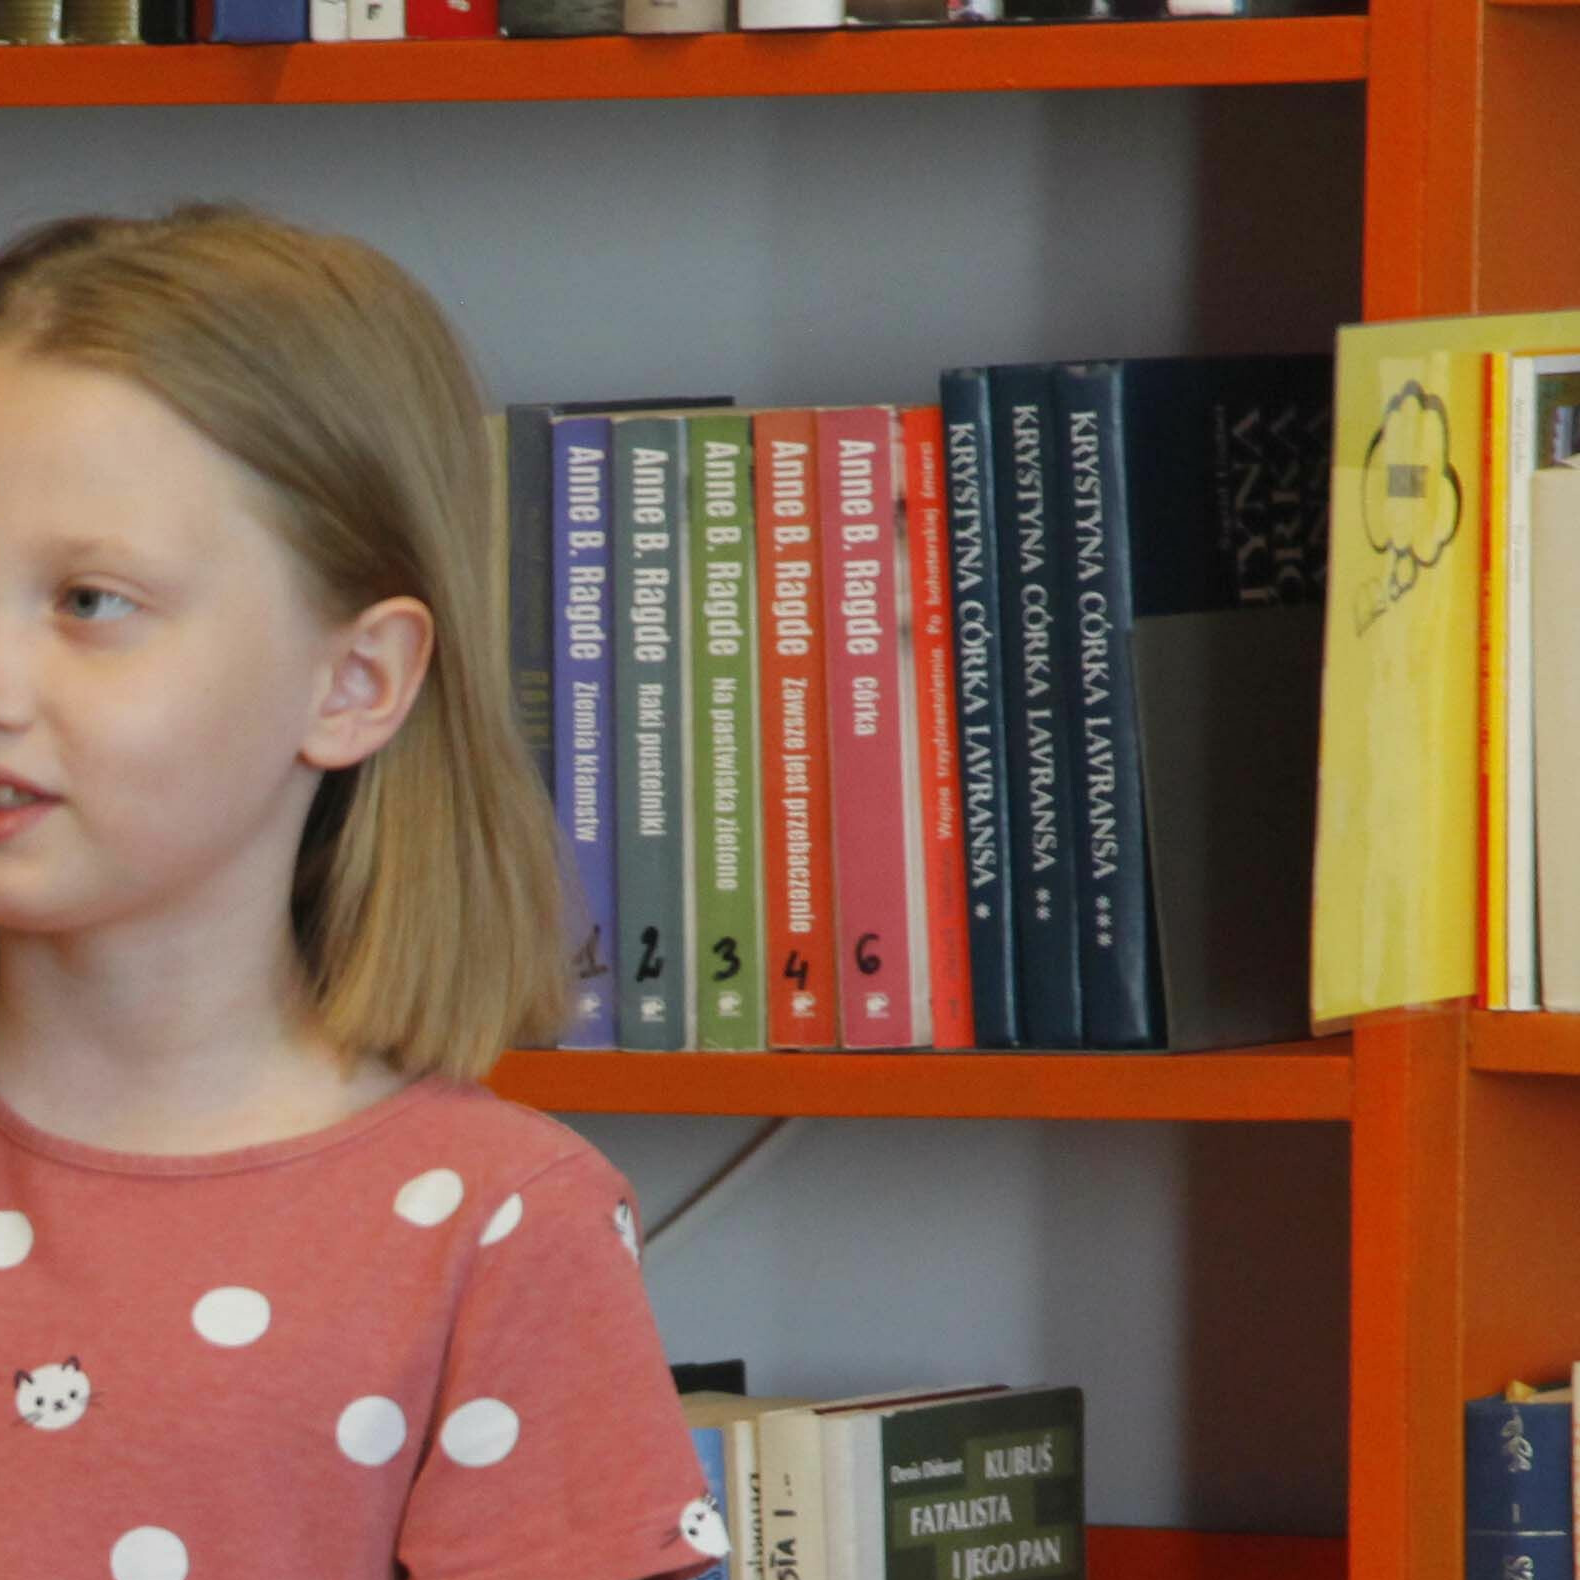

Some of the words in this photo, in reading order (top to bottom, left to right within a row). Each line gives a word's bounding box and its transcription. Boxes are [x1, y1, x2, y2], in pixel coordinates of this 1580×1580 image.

[567, 446, 604, 522] Anne
[632, 448, 668, 524] Anne
[705, 441, 739, 517] Anne
[771, 441, 808, 517] Anne
[838, 440, 875, 515] Anne
[949, 423, 983, 592] KRYSTYNA
[1012, 405, 1045, 574] KRYSTYNA
[1070, 411, 1104, 580] KRYSTYNA
[569, 530, 605, 557] B.
[633, 532, 670, 558] B.
[706, 526, 741, 552] B.
[774, 526, 810, 552] B.
[842, 524, 879, 550] B.
[566, 566, 607, 660] Ragde
[631, 568, 671, 662] Ragde
[704, 562, 742, 655] Ragde
[773, 561, 813, 655] Ragde
[842, 560, 883, 655] Ragde
[1021, 585, 1054, 697] CÓRKA
[958, 600, 993, 714] CÓRKA
[1078, 591, 1113, 705] CÓRKA
[572, 682, 600, 750] Ziemia
[637, 683, 664, 727] Raki
[713, 678, 737, 703] Na
[781, 678, 809, 749] Zawsze
[852, 677, 880, 736] Córka
[574, 754, 600, 842] kłamstw
[635, 733, 666, 836] pustelniki
[710, 709, 740, 812] pastwiska
[783, 754, 811, 794] jest
[1026, 709, 1057, 872] LAVRANSA
[1085, 717, 1118, 879] LAVRANSA
[965, 725, 997, 887] LAVRANSA
[714, 817, 739, 891] zielone
[784, 798, 816, 933] przebaczenie
[634, 926, 664, 982] 2
[711, 937, 741, 981] 3
[783, 951, 809, 989] 4
[855, 934, 882, 976] 6
[983, 1435, 1053, 1480] KUBUŚ
[910, 1495, 1013, 1536] FATALISTA
[952, 1550, 961, 1580] I
[1019, 1535, 1062, 1568] PAN
